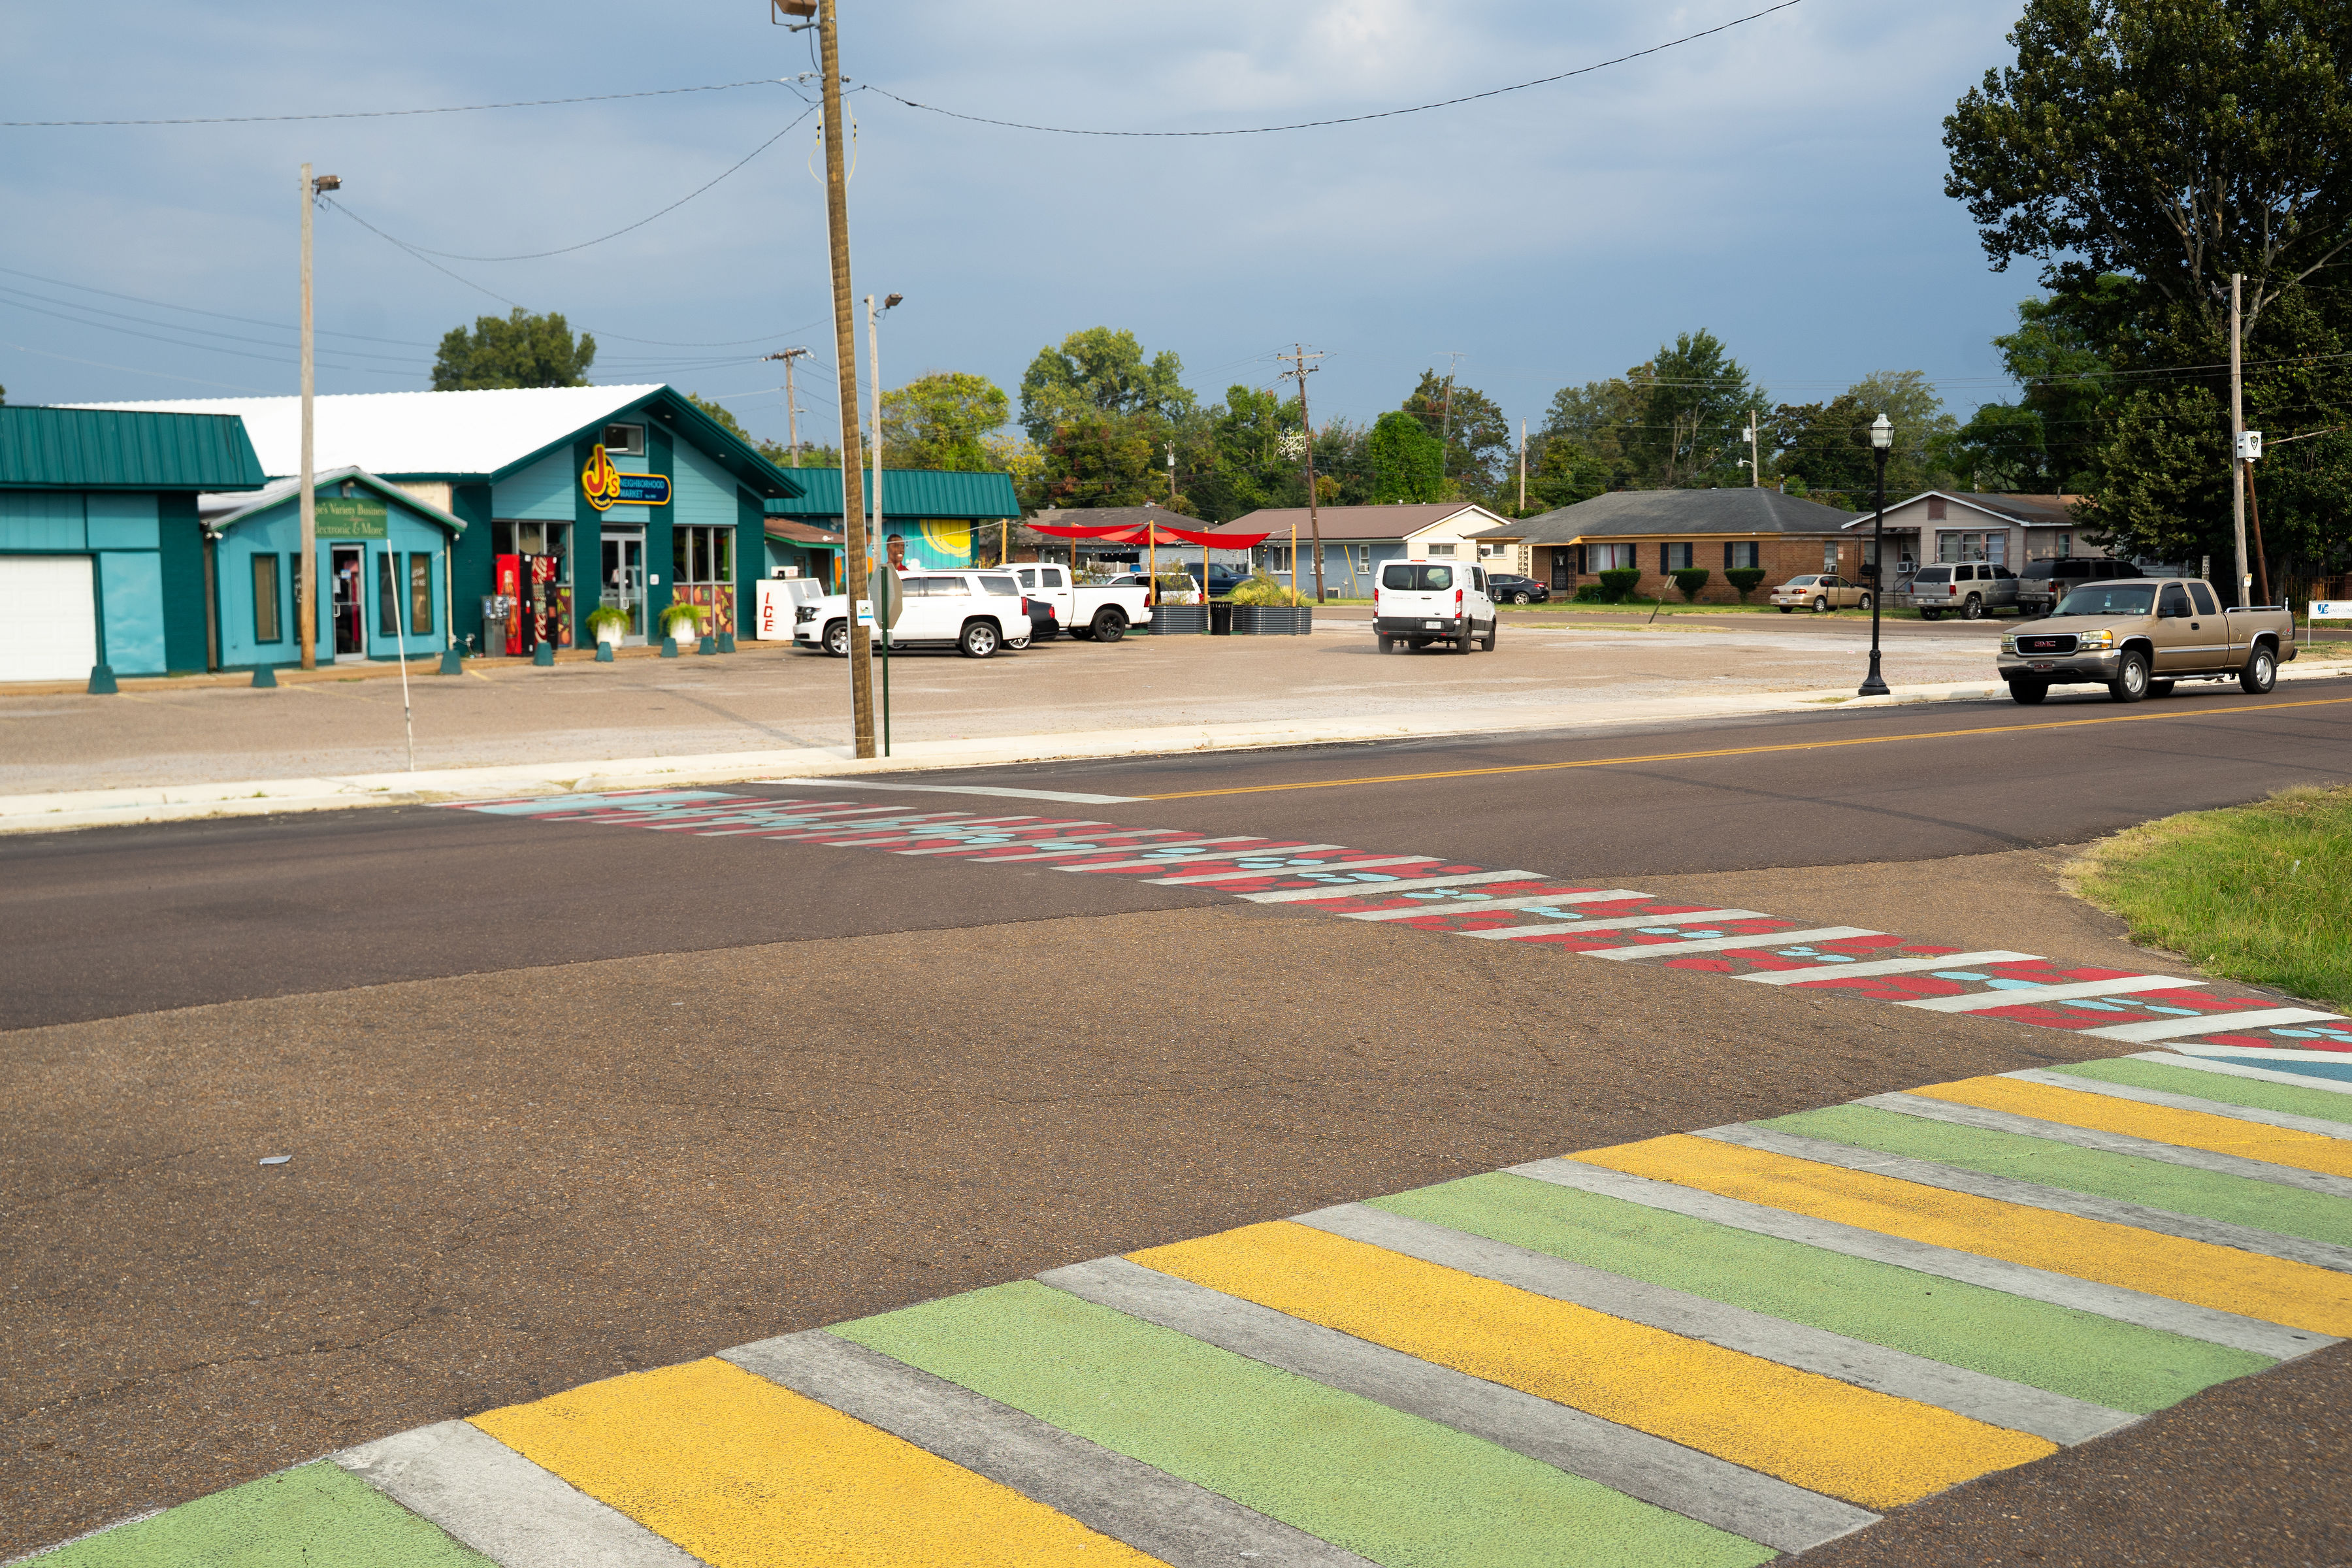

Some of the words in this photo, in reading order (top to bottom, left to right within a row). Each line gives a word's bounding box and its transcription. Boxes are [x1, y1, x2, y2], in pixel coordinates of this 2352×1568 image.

[583, 445, 619, 495] J's
[620, 478, 664, 489] NEIGHBORHOOD
[620, 489, 643, 498] MARKET
[329, 502, 355, 516] Variety
[357, 504, 387, 515] Business
[353, 523, 359, 535] &
[361, 523, 384, 534] More
[764, 592, 774, 632] ICE
